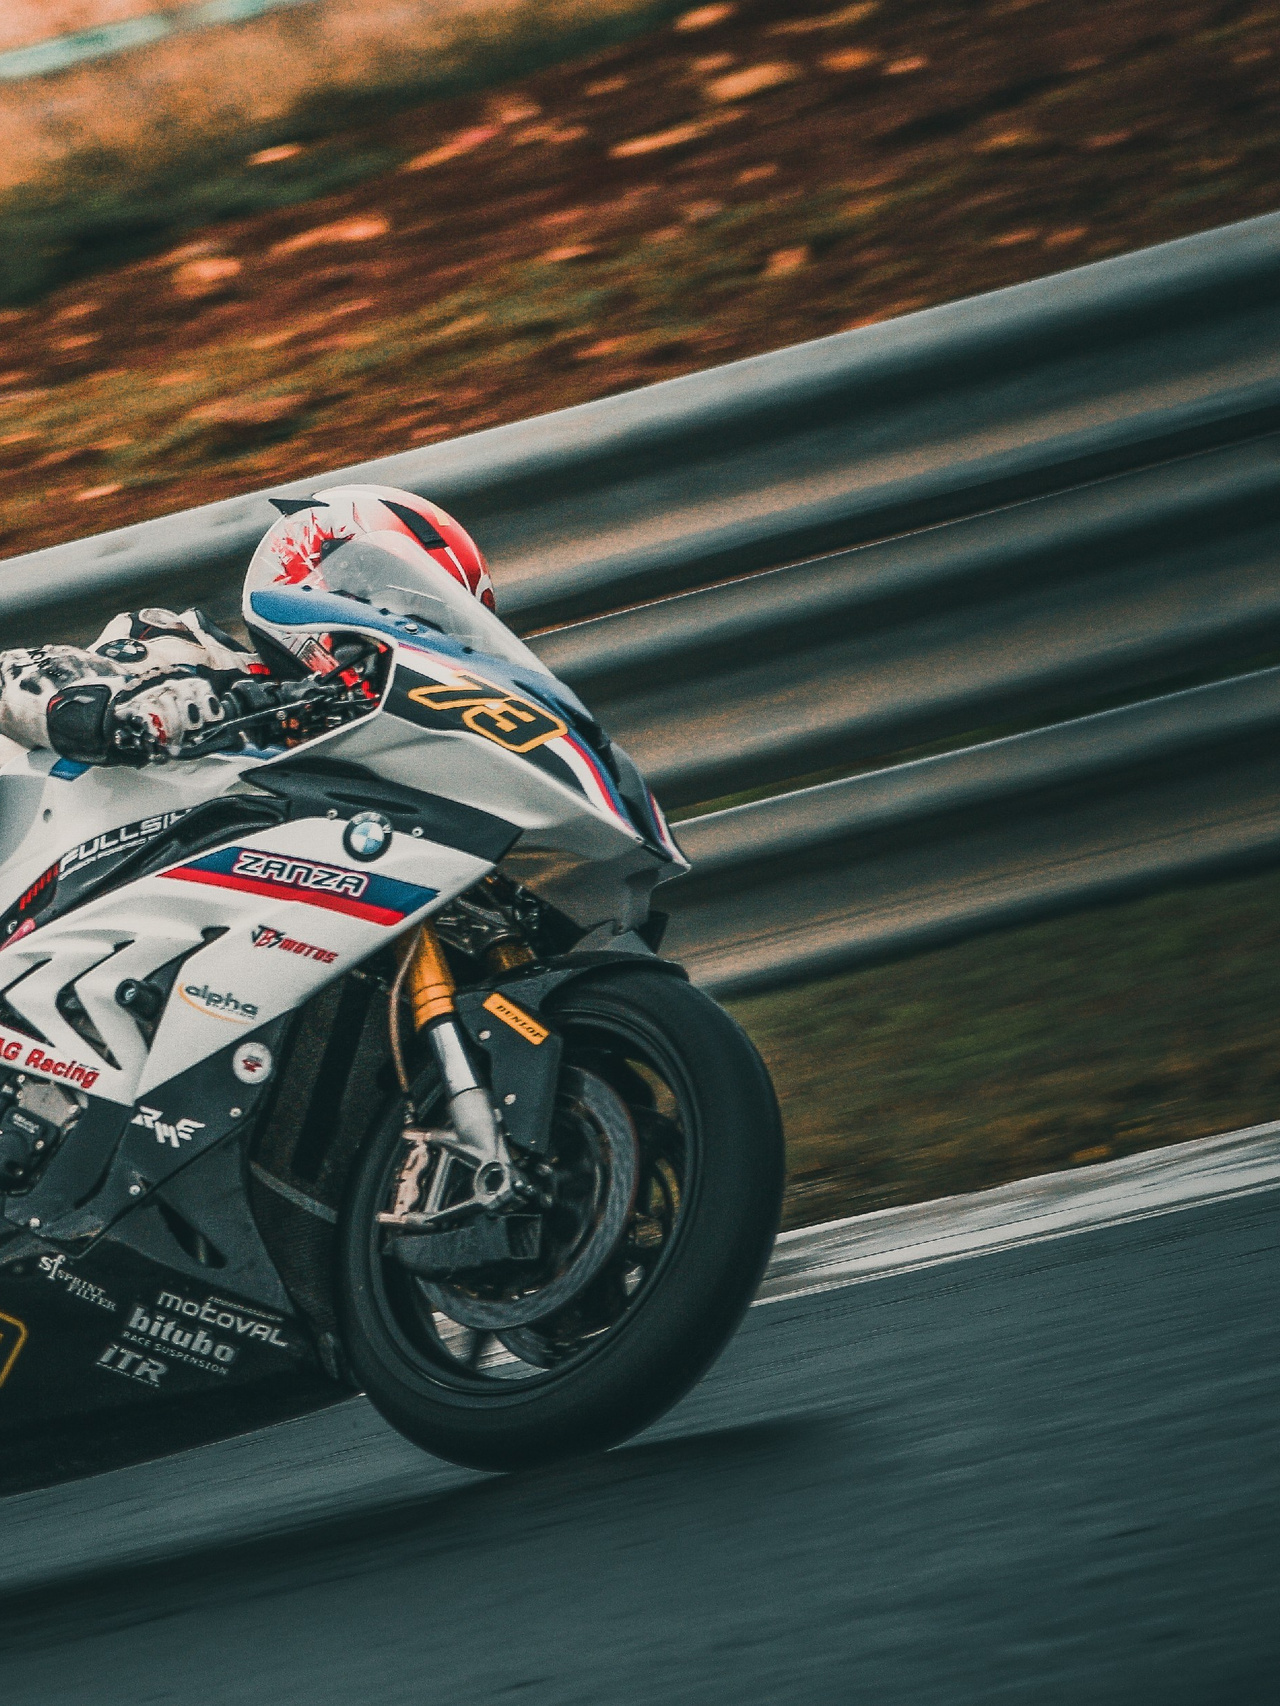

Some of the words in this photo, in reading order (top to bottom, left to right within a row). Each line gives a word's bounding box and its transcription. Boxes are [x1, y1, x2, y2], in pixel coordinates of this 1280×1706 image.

[408, 671, 568, 754] 73
[235, 853, 367, 896] ZANZA
[185, 984, 259, 1016] alpha
[495, 1005, 544, 1039] DUNLOP
[25, 1048, 100, 1089] Racing
[123, 1331, 151, 1347] RACE
[154, 1343, 229, 1375] SUSPENSION
[128, 1306, 236, 1363] bitubo
